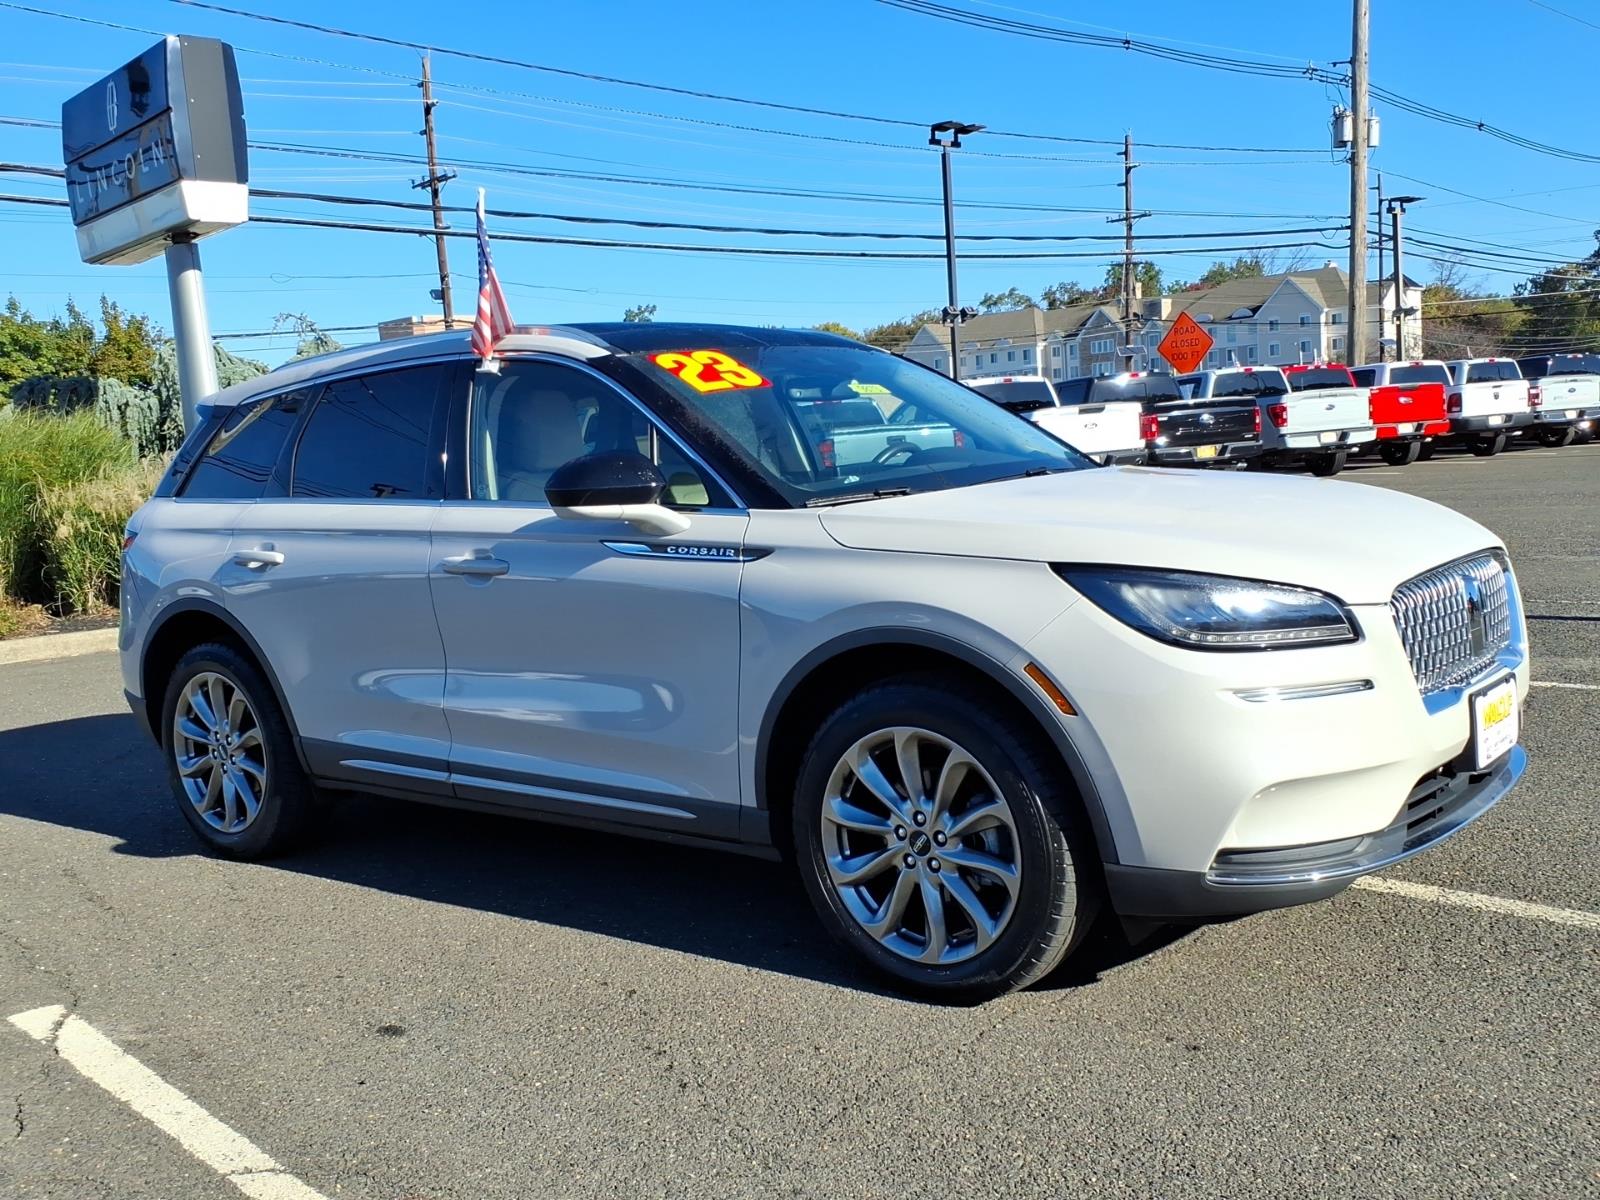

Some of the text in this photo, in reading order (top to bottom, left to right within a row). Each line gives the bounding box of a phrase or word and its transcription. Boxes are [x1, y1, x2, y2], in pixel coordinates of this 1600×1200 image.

[75, 138, 164, 203] LINCOLN
[1174, 326, 1196, 336] ROAD
[1170, 338, 1200, 348] CLOSED
[1171, 352, 1188, 361] 1000
[655, 350, 763, 392] 23
[667, 546, 735, 556] CORSAIR
